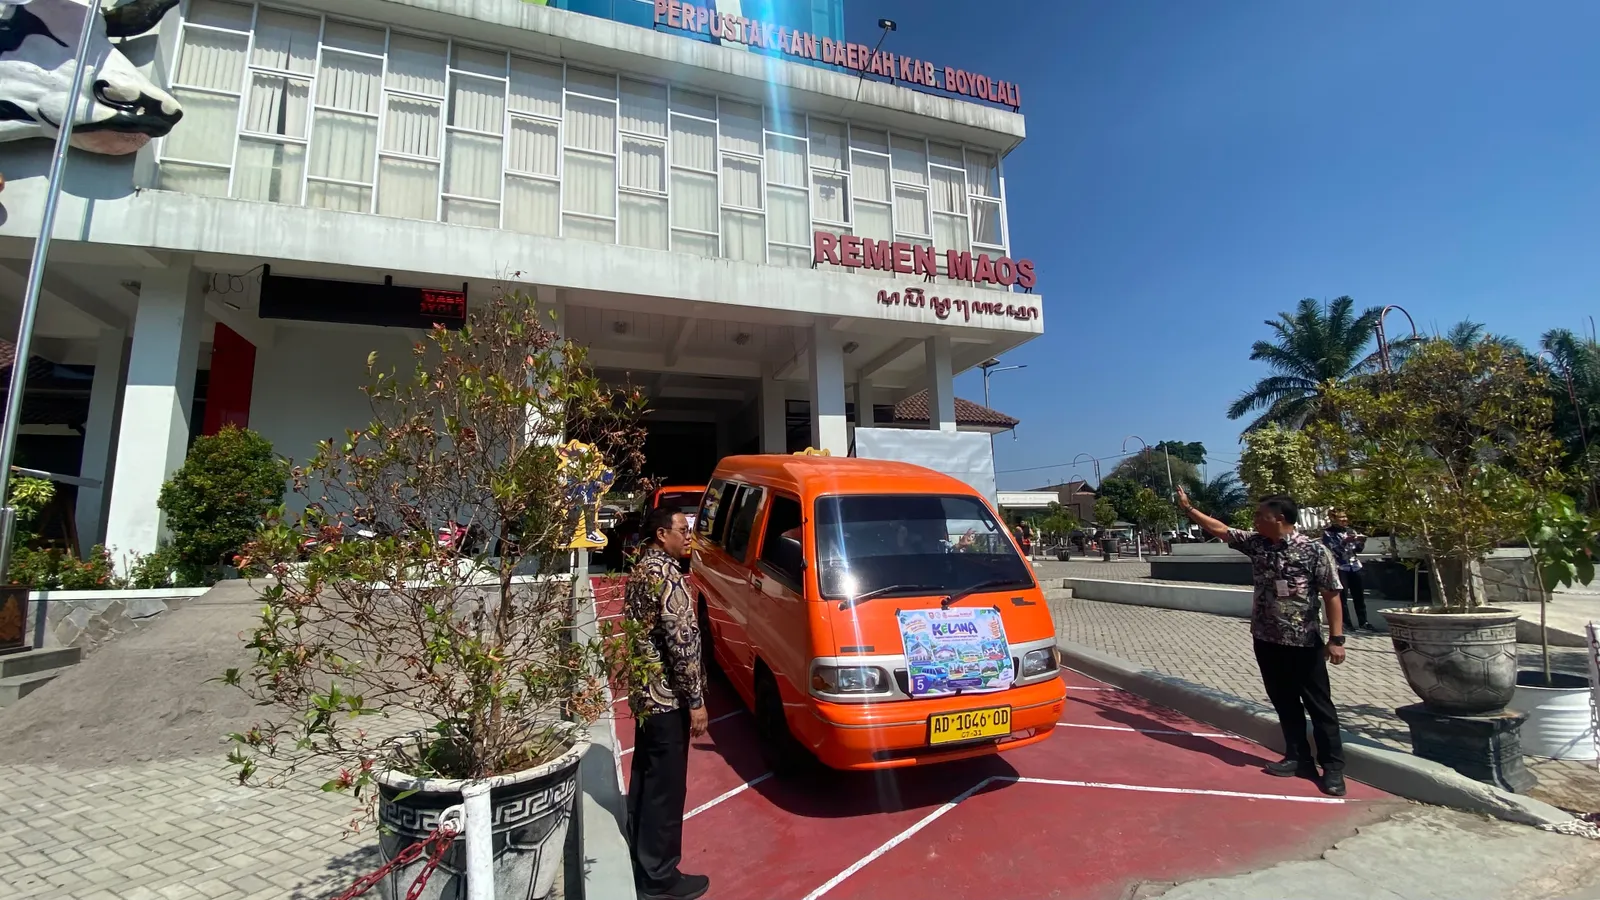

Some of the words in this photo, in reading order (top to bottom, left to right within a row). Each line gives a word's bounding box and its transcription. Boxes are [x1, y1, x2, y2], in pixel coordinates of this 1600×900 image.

[654, 0, 817, 59] PERPUSTAKAAN
[822, 37, 894, 77] DAERAH
[899, 57, 941, 86] KAB.
[944, 67, 1020, 106] BOYOLALI
[814, 231, 937, 276] REMEN
[947, 249, 1037, 288] MAOS
[917, 679, 925, 691] 5
[934, 716, 949, 733] AD
[956, 713, 987, 730] 1046
[993, 709, 1008, 726] OD
